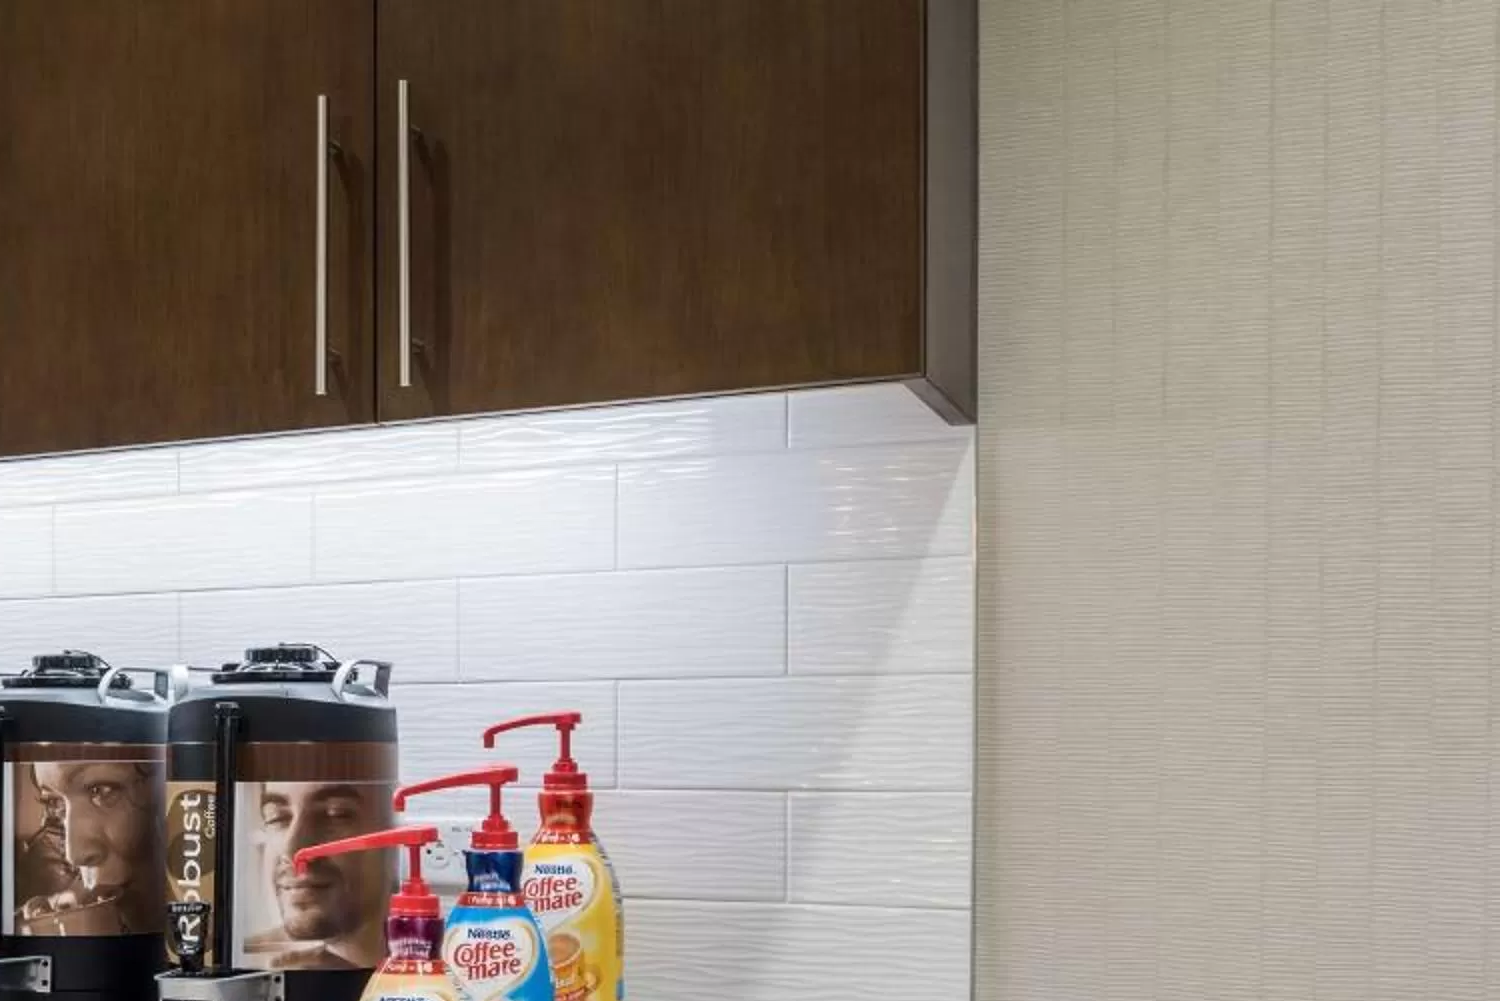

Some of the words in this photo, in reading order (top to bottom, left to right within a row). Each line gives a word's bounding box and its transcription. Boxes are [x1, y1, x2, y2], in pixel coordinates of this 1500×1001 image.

[523, 876, 577, 900] Coffee
[534, 891, 583, 912] mate
[453, 942, 516, 968] Coffee
[467, 958, 521, 980] mate
